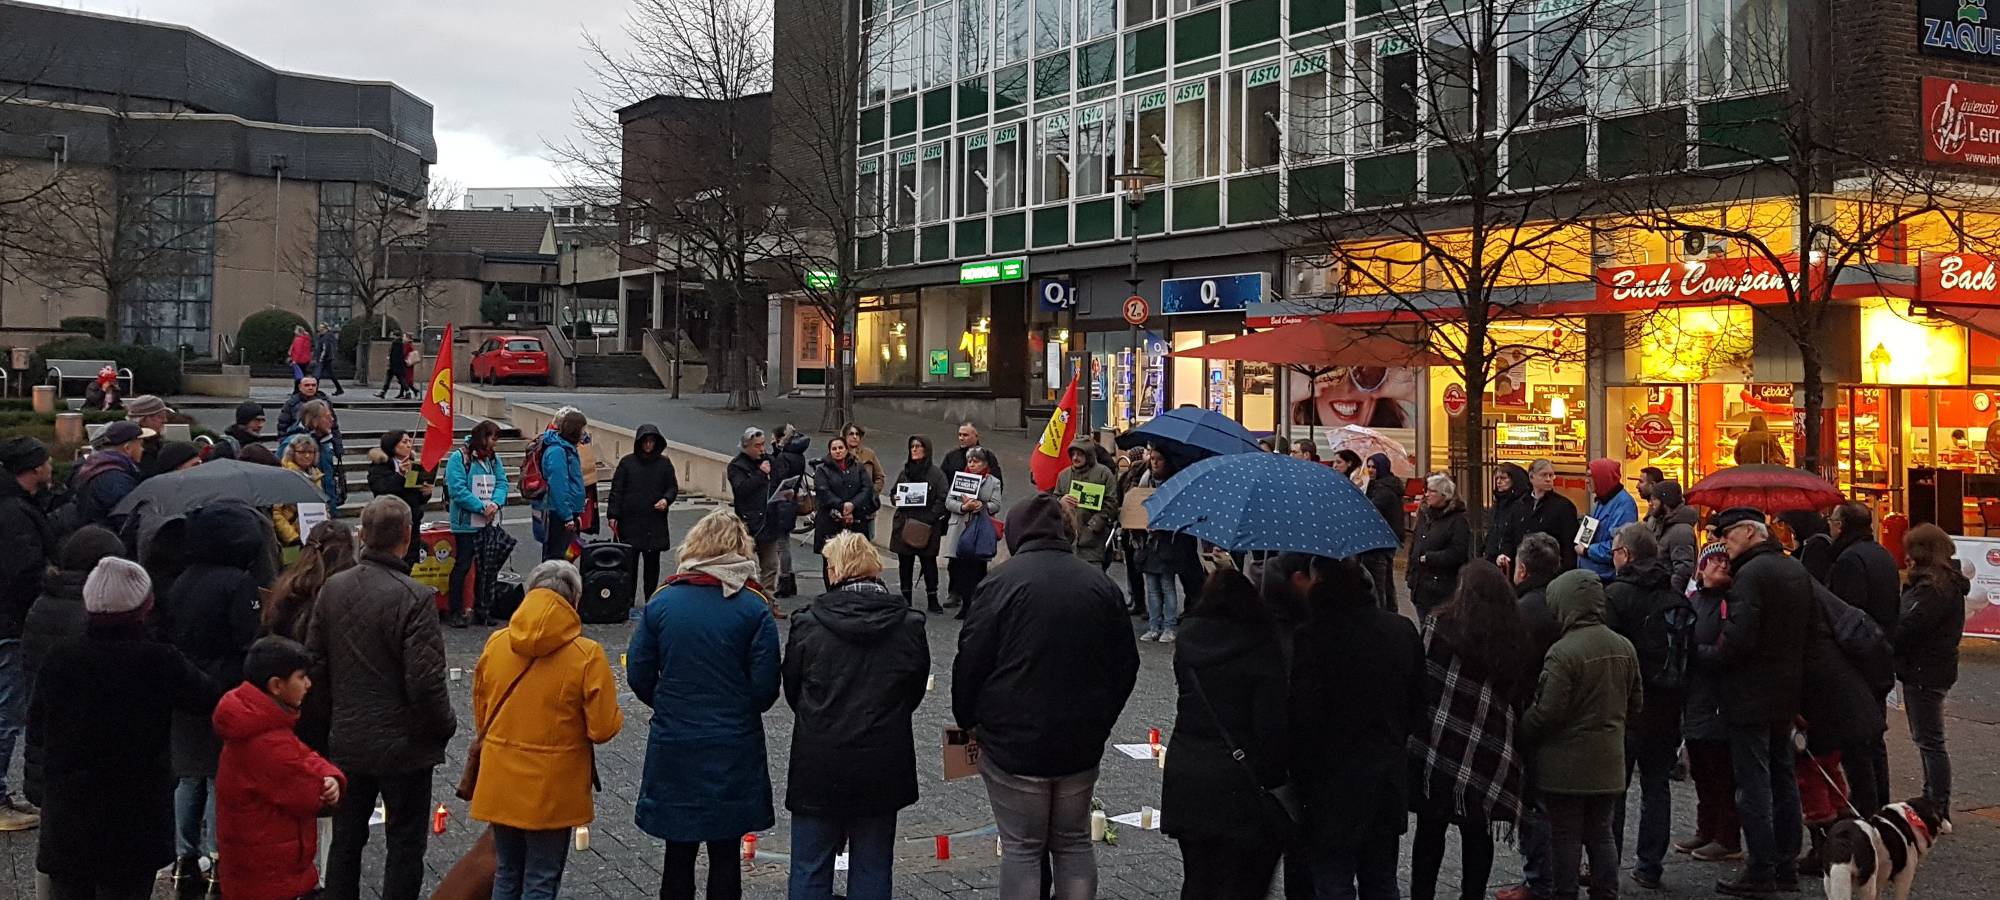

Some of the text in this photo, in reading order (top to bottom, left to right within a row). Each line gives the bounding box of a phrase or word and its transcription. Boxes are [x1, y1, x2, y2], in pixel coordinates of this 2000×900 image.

[1292, 54, 1327, 75] ASTO
[1249, 65, 1281, 85] ASTO
[1176, 83, 1205, 101] ASTO
[1140, 93, 1167, 110] ASTO
[1078, 107, 1104, 125] ASTO
[995, 127, 1017, 142] ASTO
[923, 146, 942, 159] ASTO
[860, 160, 877, 173] ASTO
[1940, 255, 1997, 291] Back
[1612, 267, 1672, 300] Back
[1200, 280, 1220, 308] O2
